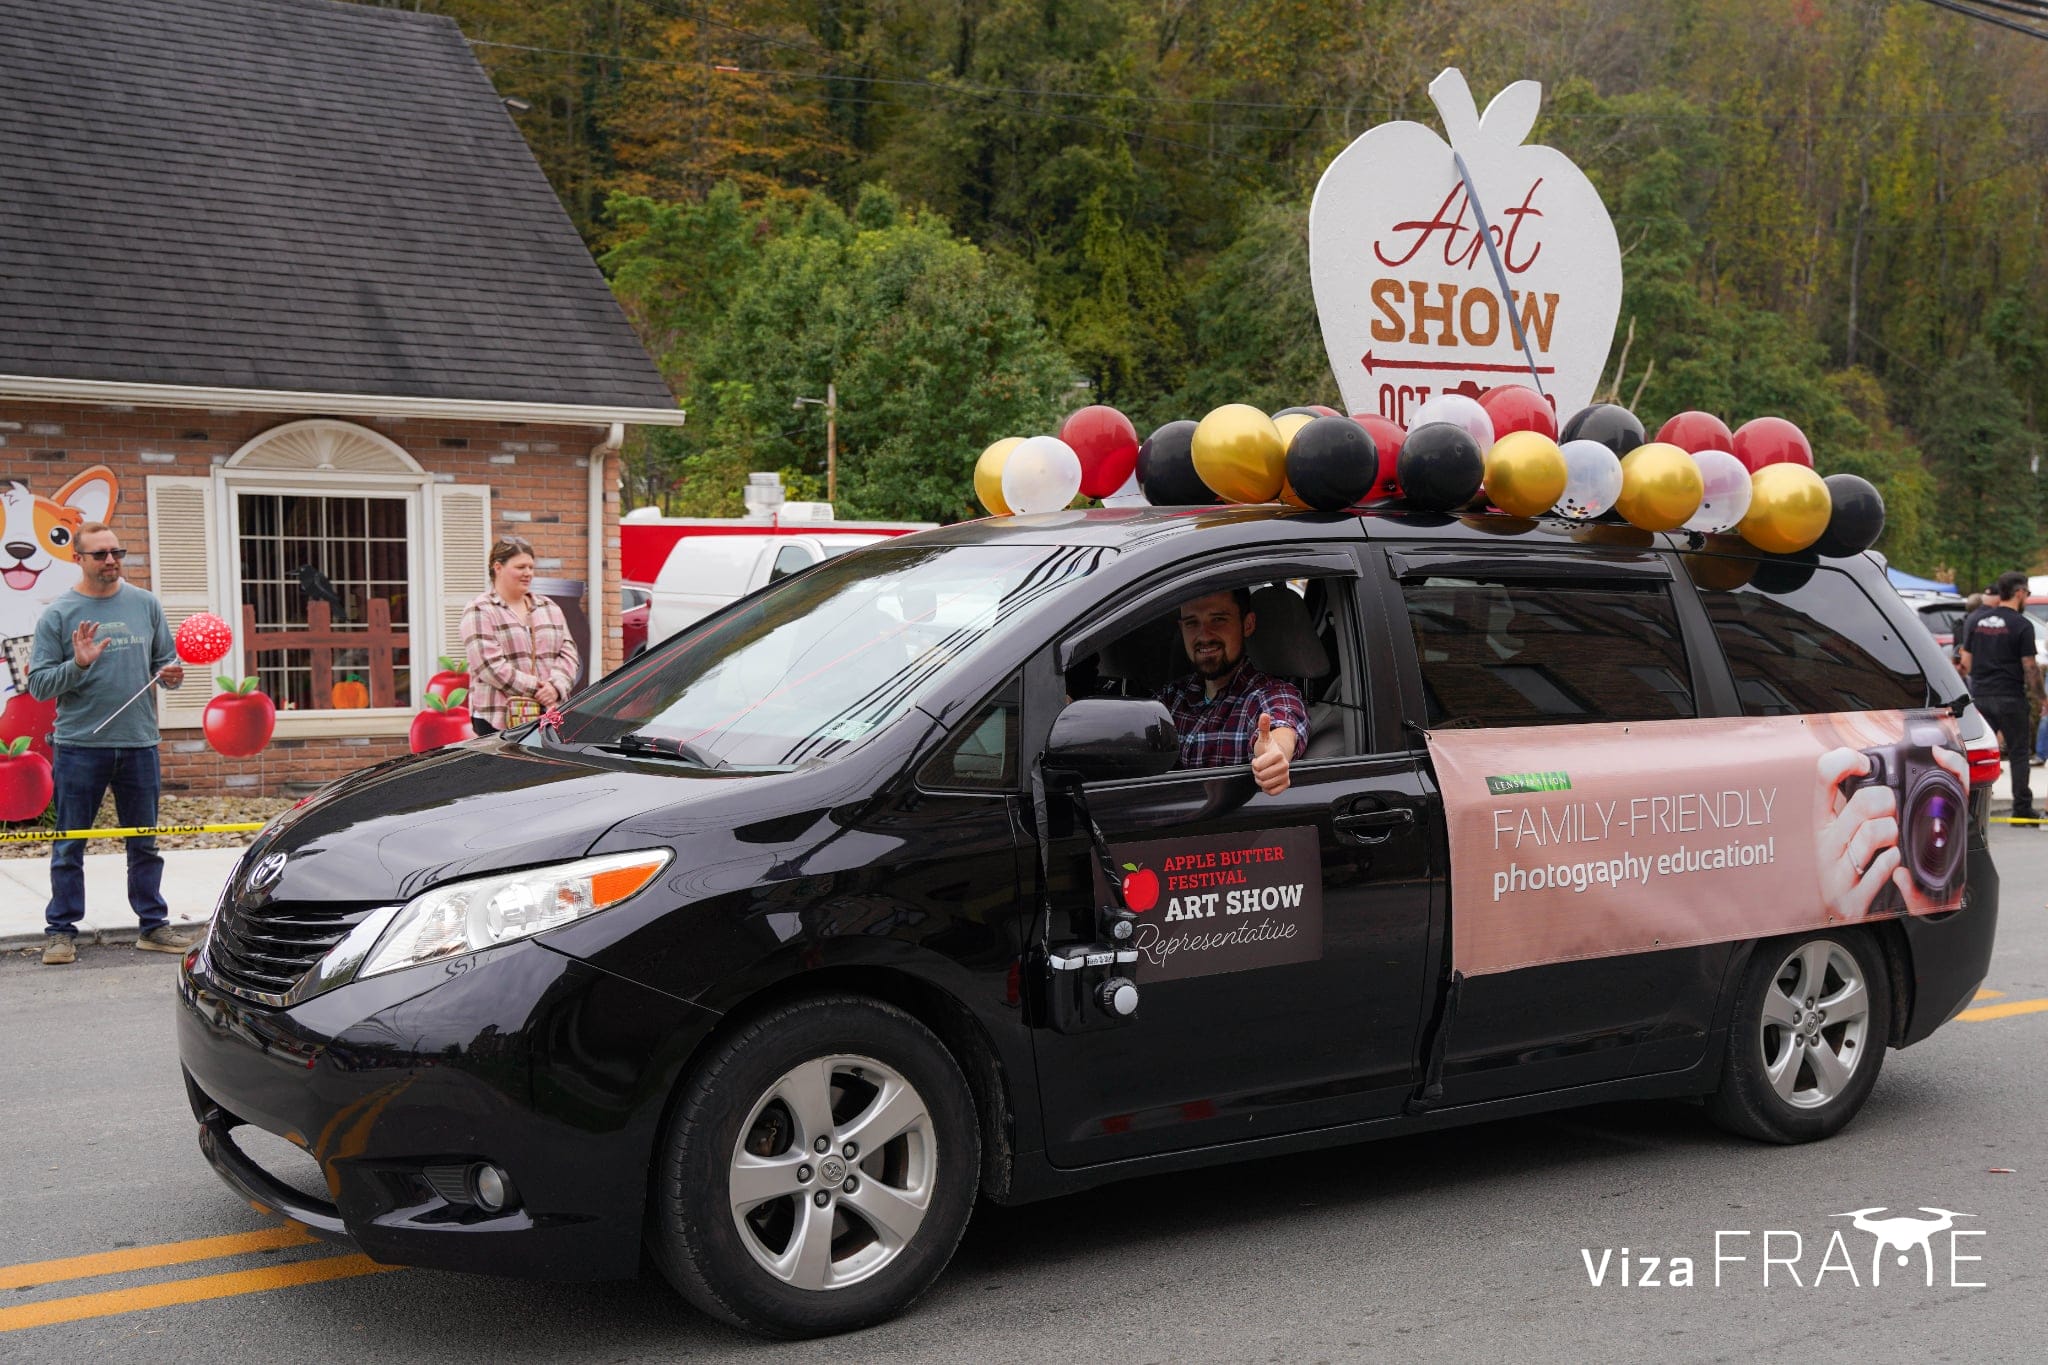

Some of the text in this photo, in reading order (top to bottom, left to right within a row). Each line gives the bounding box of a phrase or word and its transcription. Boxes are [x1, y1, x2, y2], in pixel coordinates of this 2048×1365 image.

[1374, 178, 1544, 274] Art
[1370, 278, 1560, 353] SHOW
[1492, 787, 1778, 850] FAMILY-FRIENDLY
[1164, 846, 1285, 872] APPLE BUTTER
[1168, 869, 1247, 891] FESTIVAL
[1493, 837, 1775, 902] photography education!
[1164, 884, 1304, 922] ART SHOW
[1136, 917, 1299, 968] Representative
